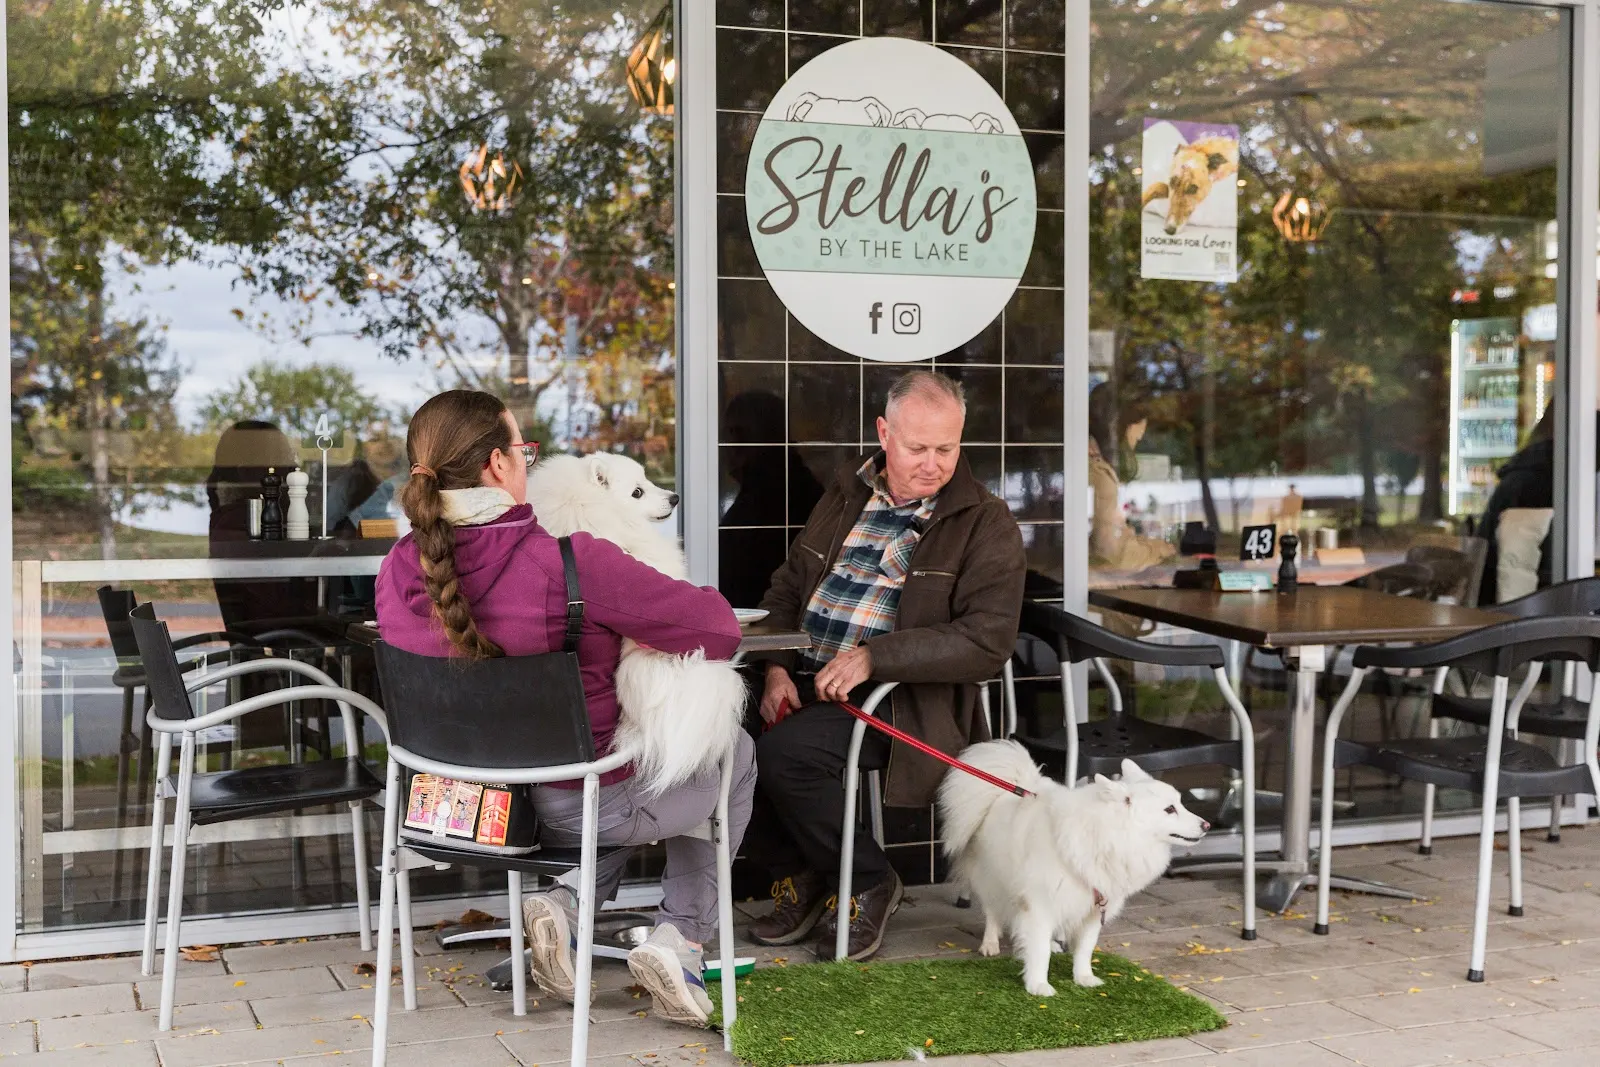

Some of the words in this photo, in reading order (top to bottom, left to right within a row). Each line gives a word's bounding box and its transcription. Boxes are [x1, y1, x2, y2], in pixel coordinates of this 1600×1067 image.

[756, 136, 1018, 243] Stella's
[819, 238, 847, 256] BY
[859, 240, 902, 259] THE
[914, 242, 969, 261] LAKE
[1145, 236, 1182, 246] LOOKING
[1184, 238, 1200, 248] FOR
[314, 413, 331, 441] 4
[1245, 528, 1273, 555] 43
